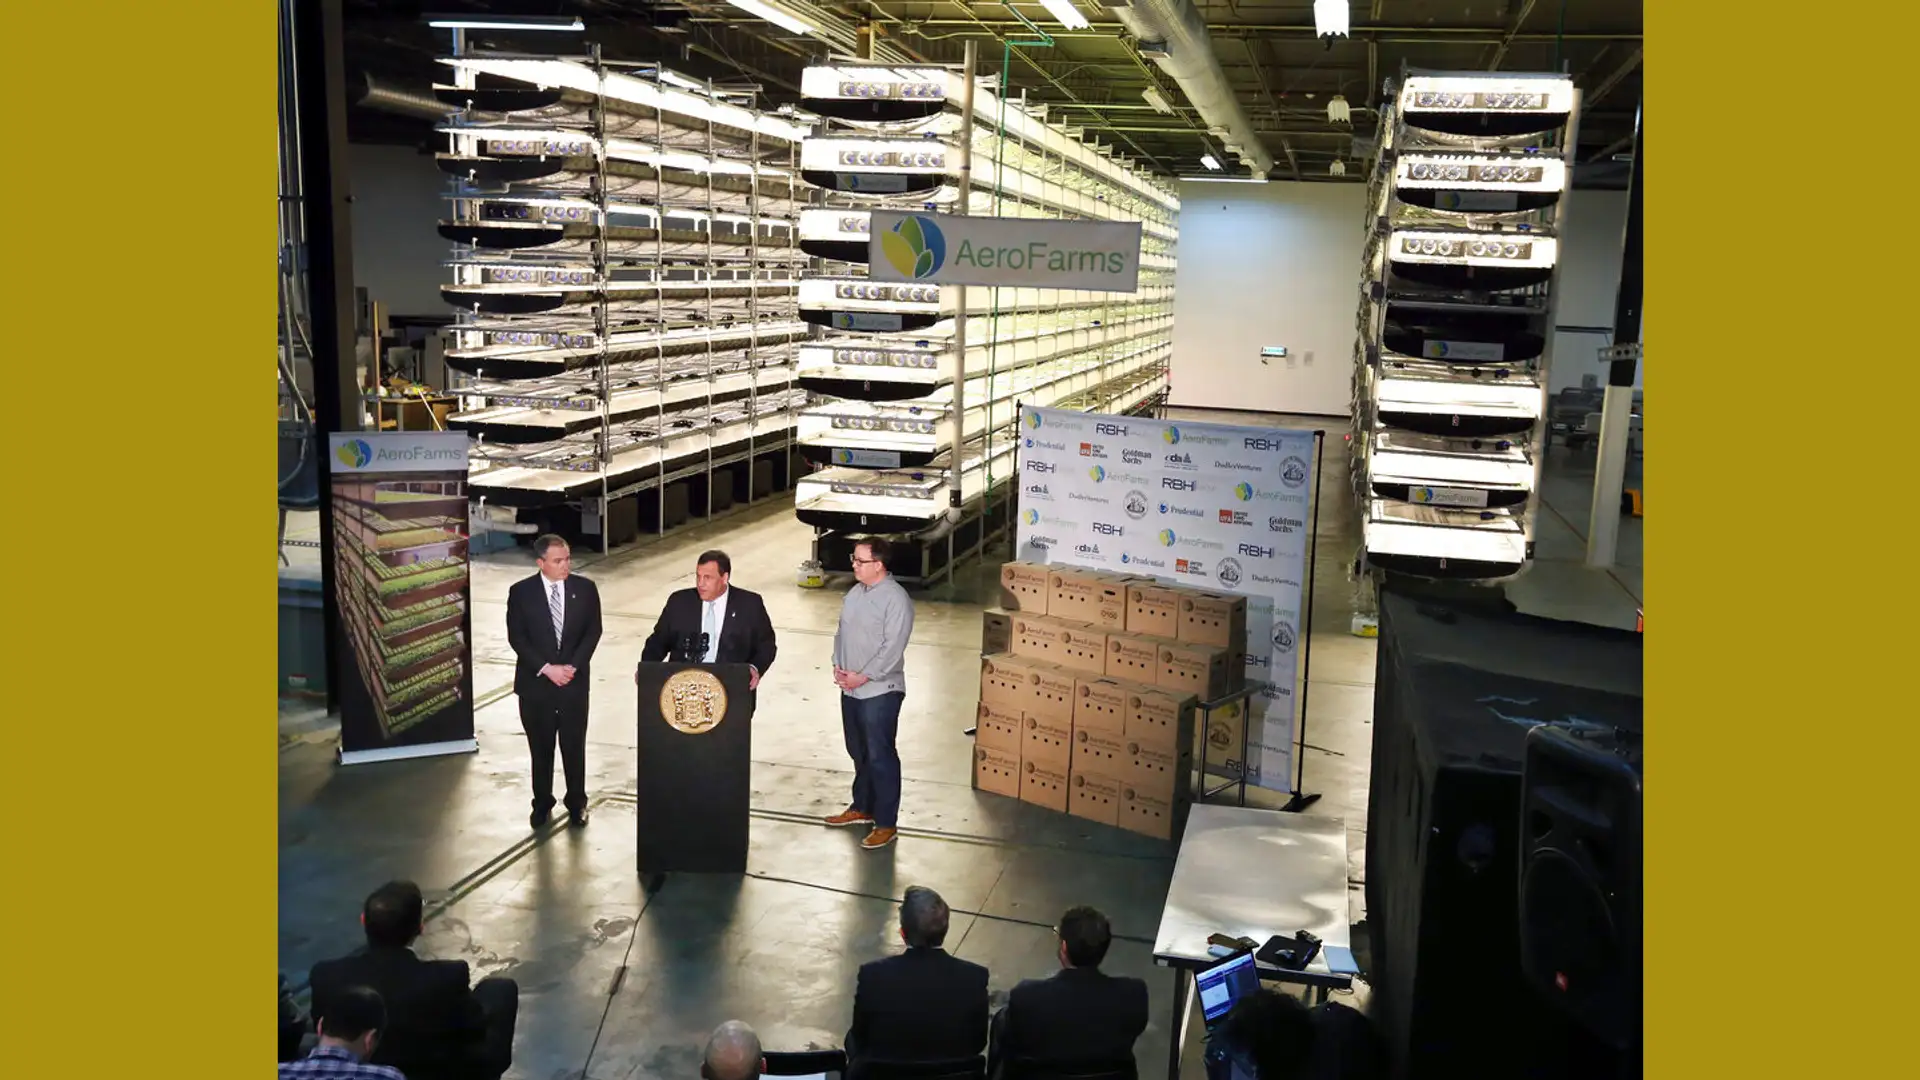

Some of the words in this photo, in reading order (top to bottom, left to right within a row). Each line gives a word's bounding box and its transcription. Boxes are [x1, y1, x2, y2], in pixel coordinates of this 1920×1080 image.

[955, 239, 1124, 275] AeroFarms
[1096, 422, 1128, 437] RBH
[1244, 437, 1280, 452] RBH
[376, 445, 462, 461] AeroFarms
[1026, 460, 1055, 474] RBH
[1162, 477, 1195, 492] RBH
[1170, 506, 1204, 518] Prudential
[1092, 522, 1123, 536] RBH
[1269, 516, 1303, 527] Goldman
[1269, 524, 1294, 533] Sachs
[1238, 543, 1272, 558] RBH
